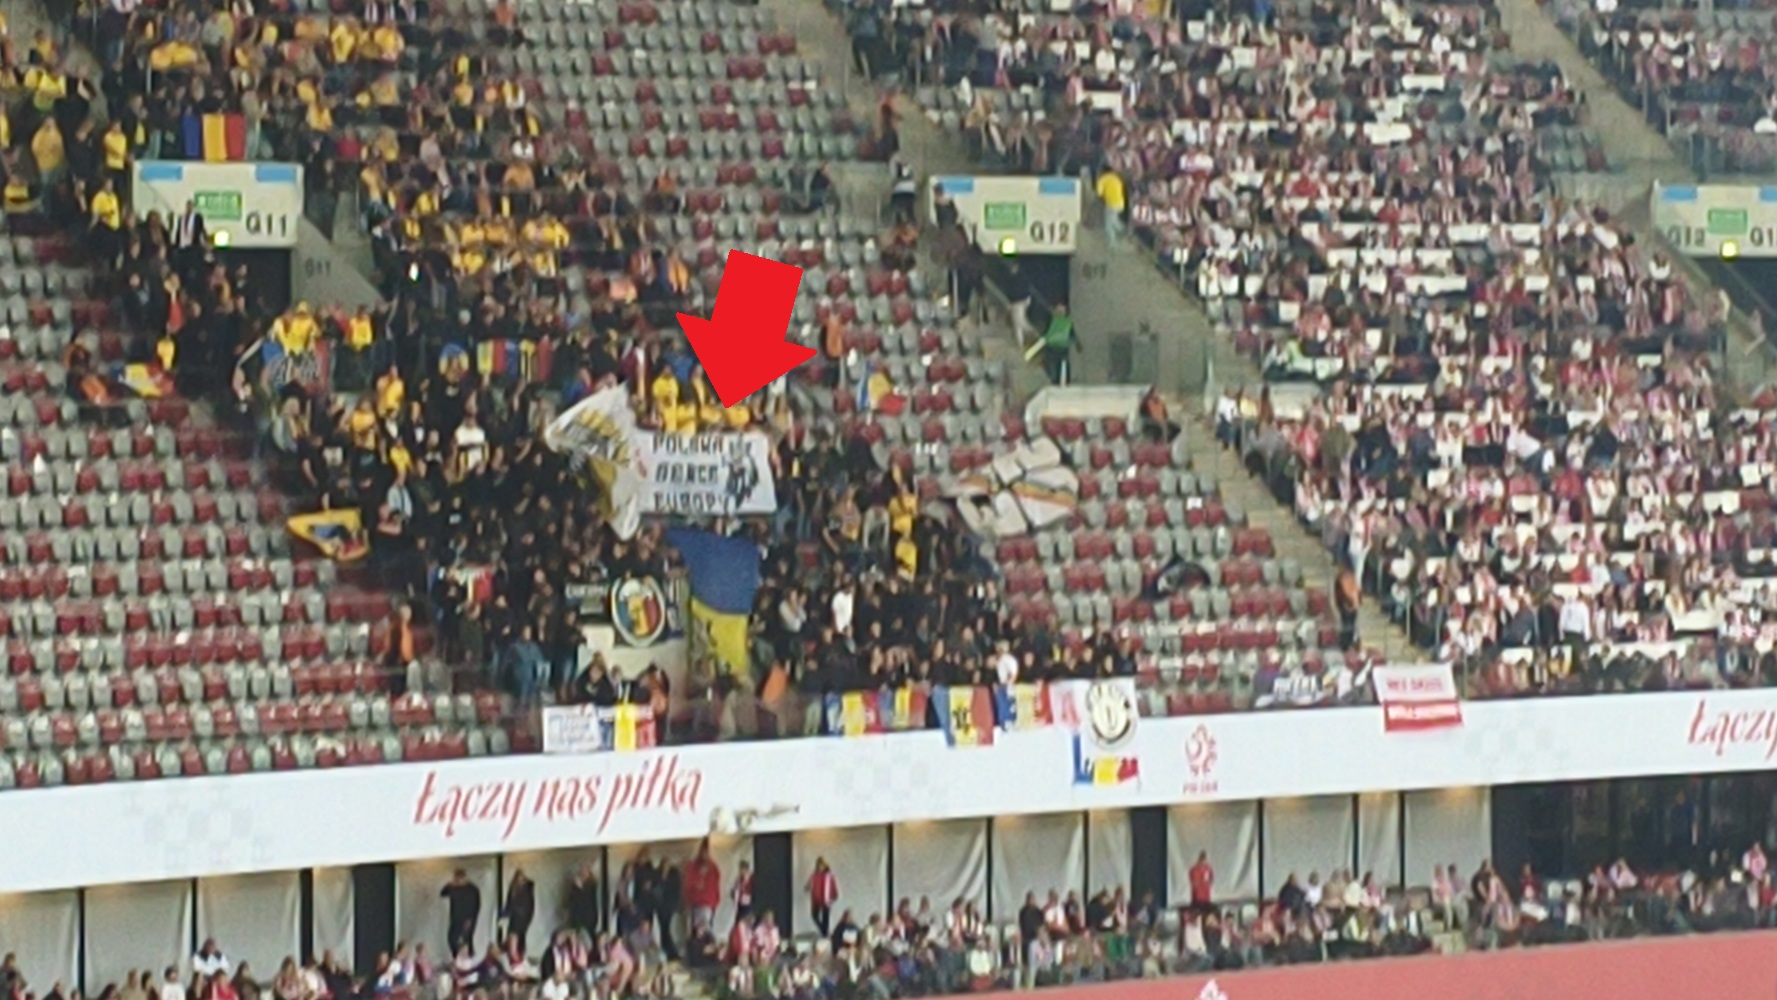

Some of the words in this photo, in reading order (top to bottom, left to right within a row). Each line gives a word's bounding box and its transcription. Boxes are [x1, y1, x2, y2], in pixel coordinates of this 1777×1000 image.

[413, 770, 528, 840] Łączy
[532, 776, 602, 822] nas
[597, 753, 702, 836] piłka
